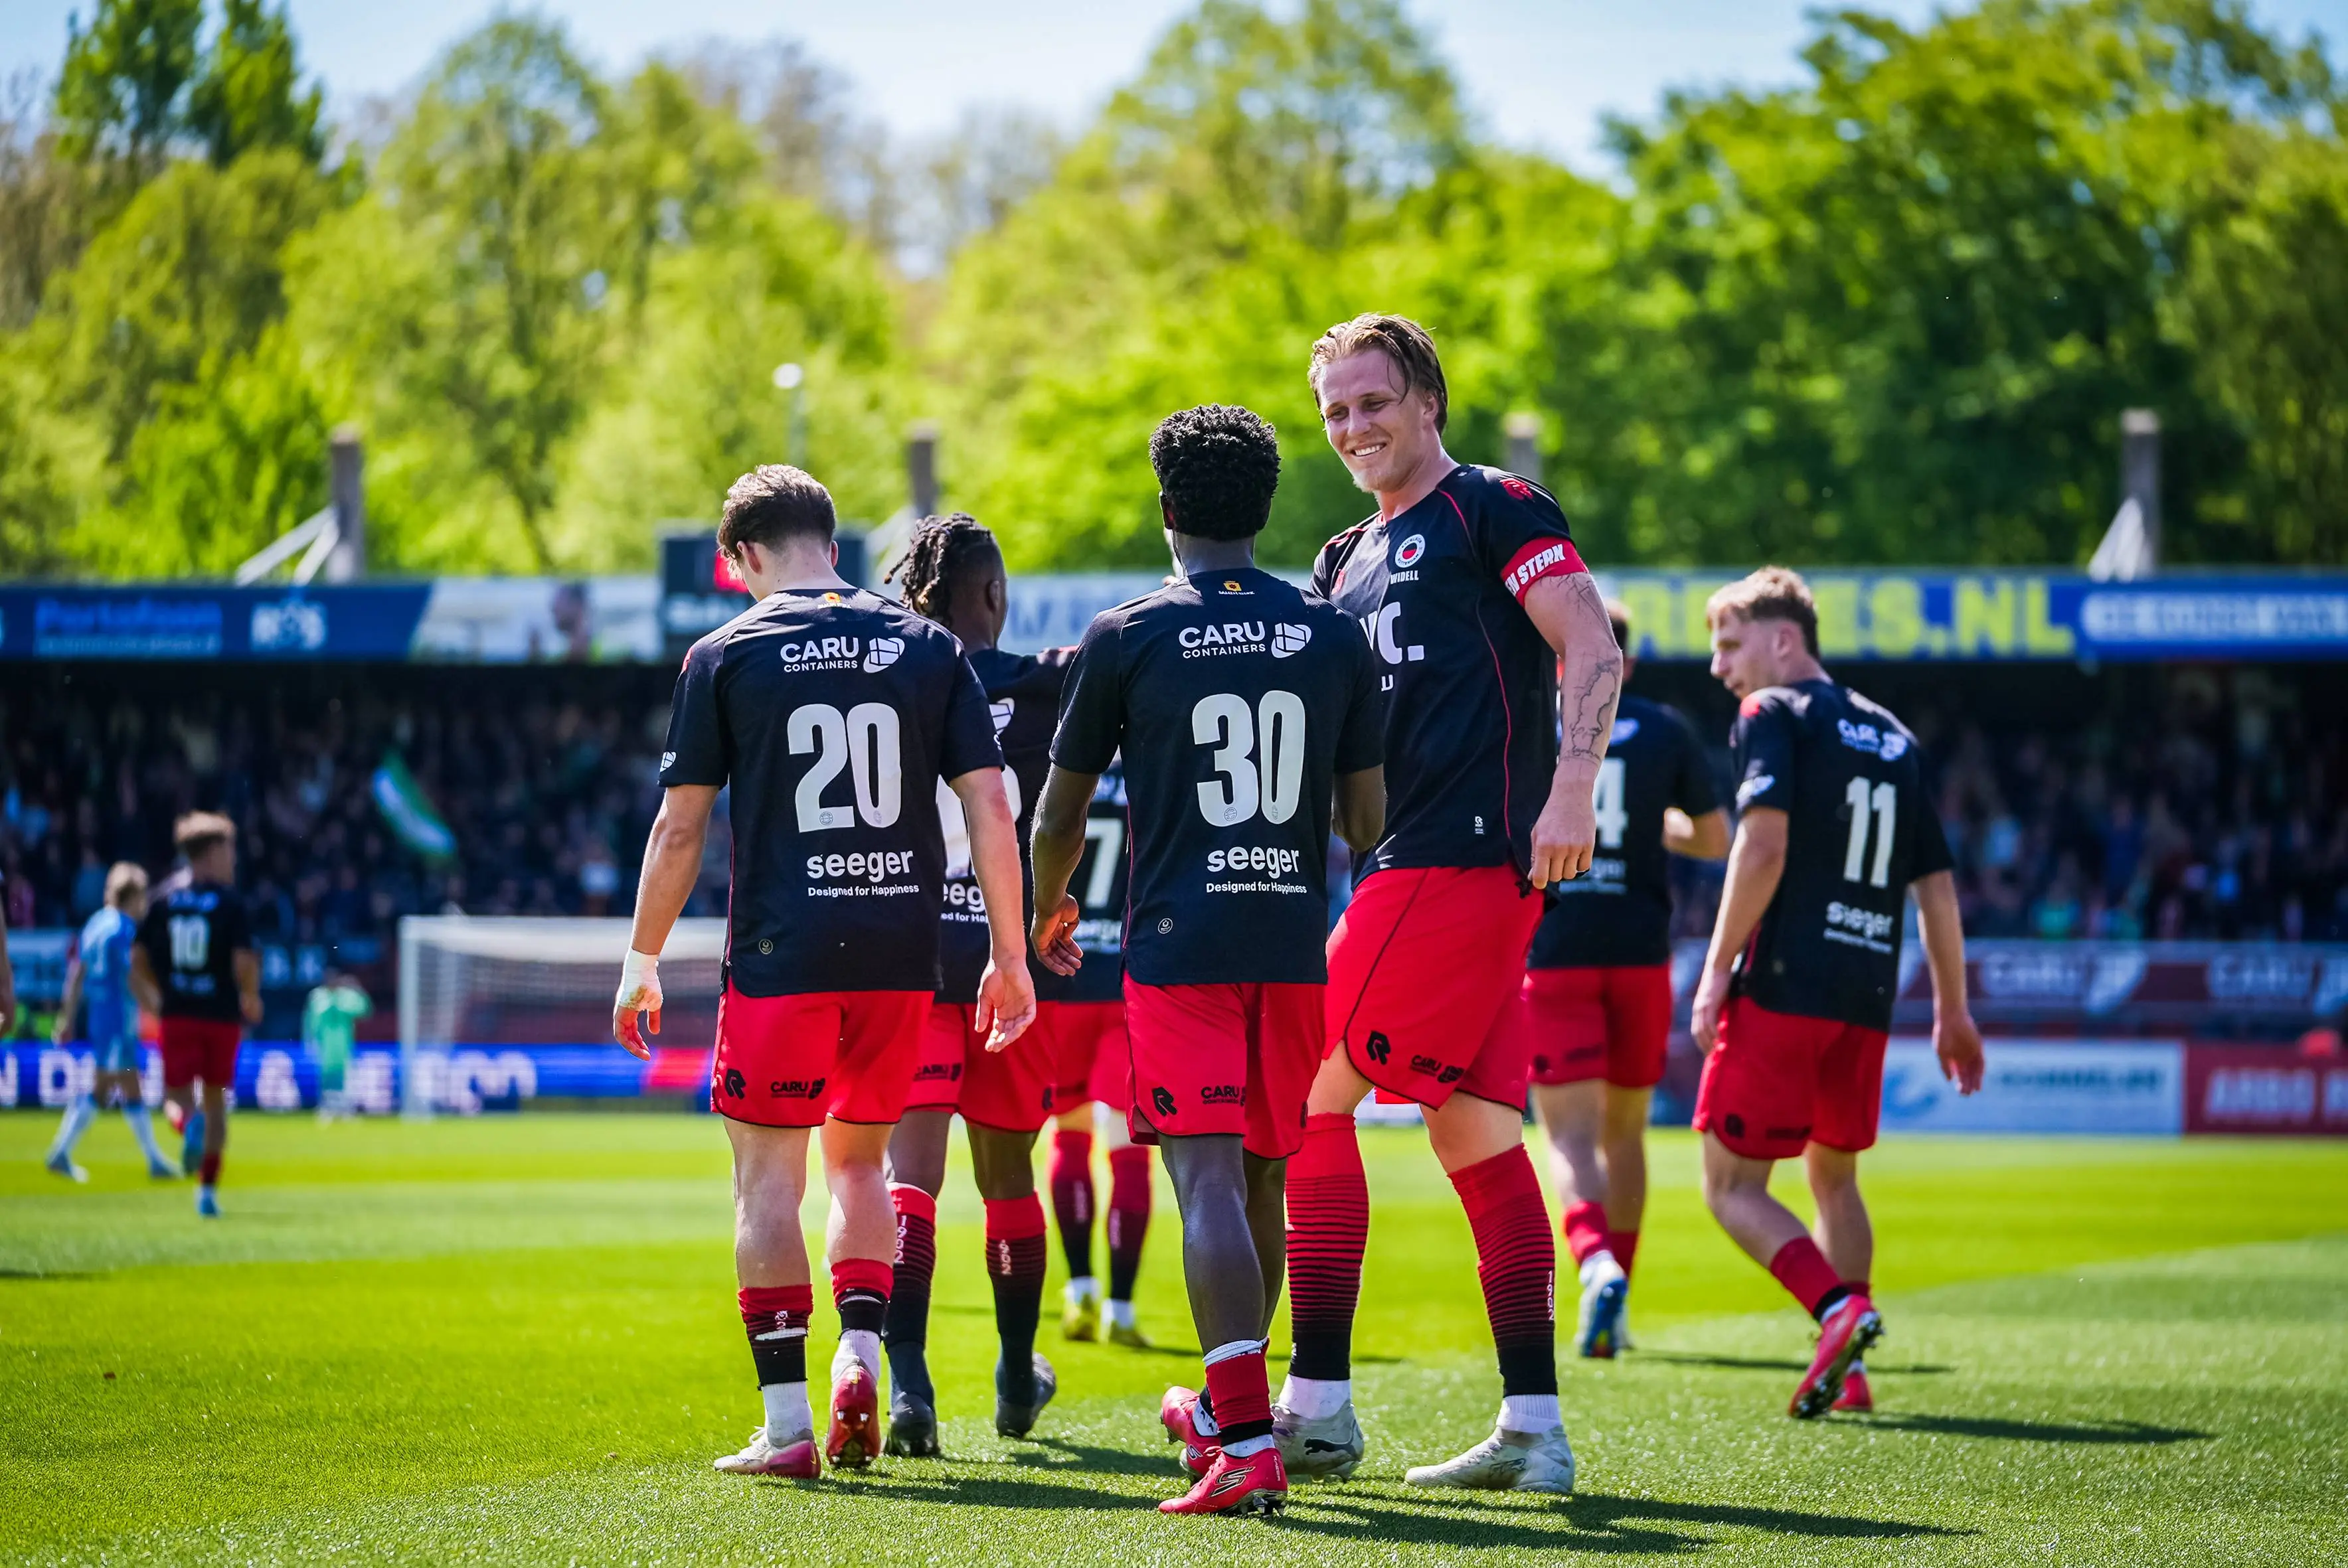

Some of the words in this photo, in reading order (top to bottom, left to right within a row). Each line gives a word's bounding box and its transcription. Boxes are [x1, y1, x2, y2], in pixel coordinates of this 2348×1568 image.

[1390, 570, 1419, 584] WIDELL
[1517, 544, 1566, 585] STERK
[780, 636, 859, 663] CARU
[1178, 621, 1266, 649] CARU
[1182, 643, 1266, 659] CONTAINERS
[784, 660, 858, 673] CONTAINERS
[787, 702, 902, 833] 20
[1192, 690, 1306, 827] 30
[1592, 756, 1630, 849] 4
[1843, 776, 1896, 888] 11
[806, 850, 914, 883] seeger
[1207, 846, 1300, 879] seeger
[807, 886, 853, 898] Designed
[855, 886, 870, 896] for
[871, 884, 920, 896] Happiness
[1206, 882, 1256, 894] Designed
[1258, 882, 1271, 892] for
[1271, 882, 1307, 895] Happiness
[955, 913, 970, 921] for
[167, 913, 210, 971] 10
[770, 1081, 809, 1093] CARU
[1201, 1085, 1240, 1099] CARU
[894, 1215, 908, 1265] 1902
[999, 1239, 1013, 1275] 902
